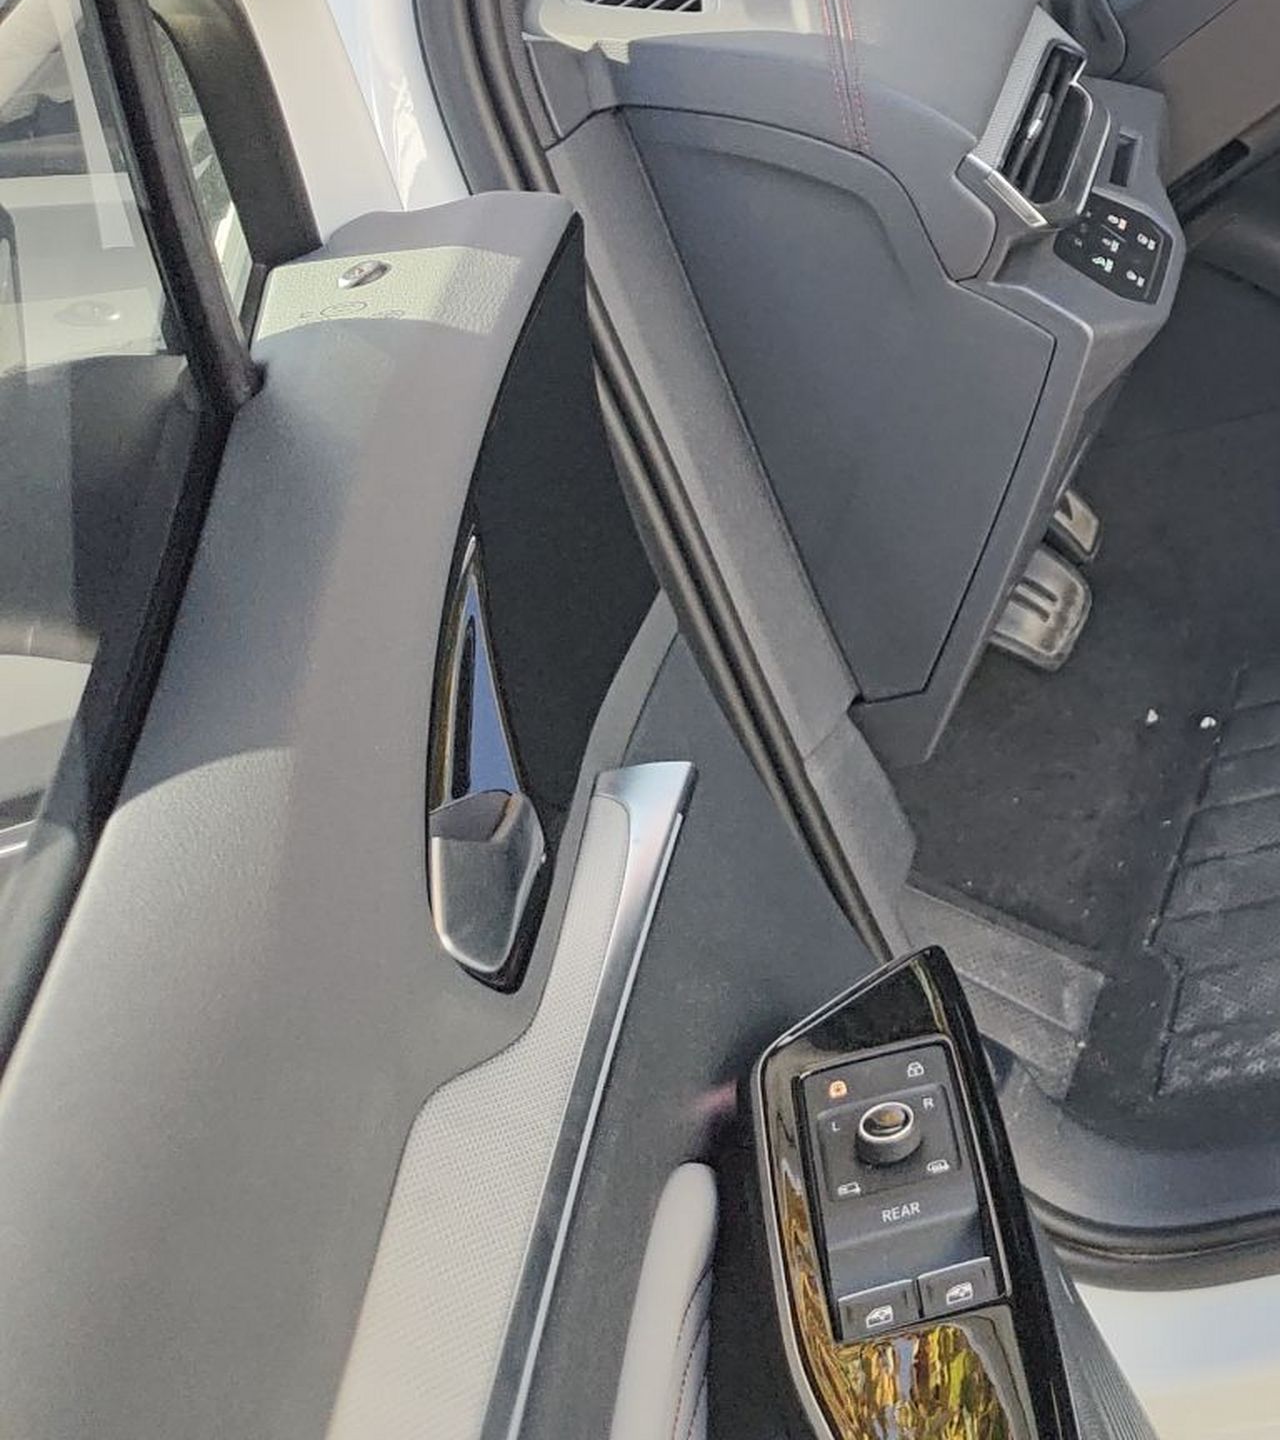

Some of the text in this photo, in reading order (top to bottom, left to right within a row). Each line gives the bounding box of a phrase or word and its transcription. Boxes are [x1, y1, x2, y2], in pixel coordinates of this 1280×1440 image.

[922, 1097, 935, 1110] R
[831, 1122, 842, 1132] L
[881, 1201, 921, 1223] REAR
